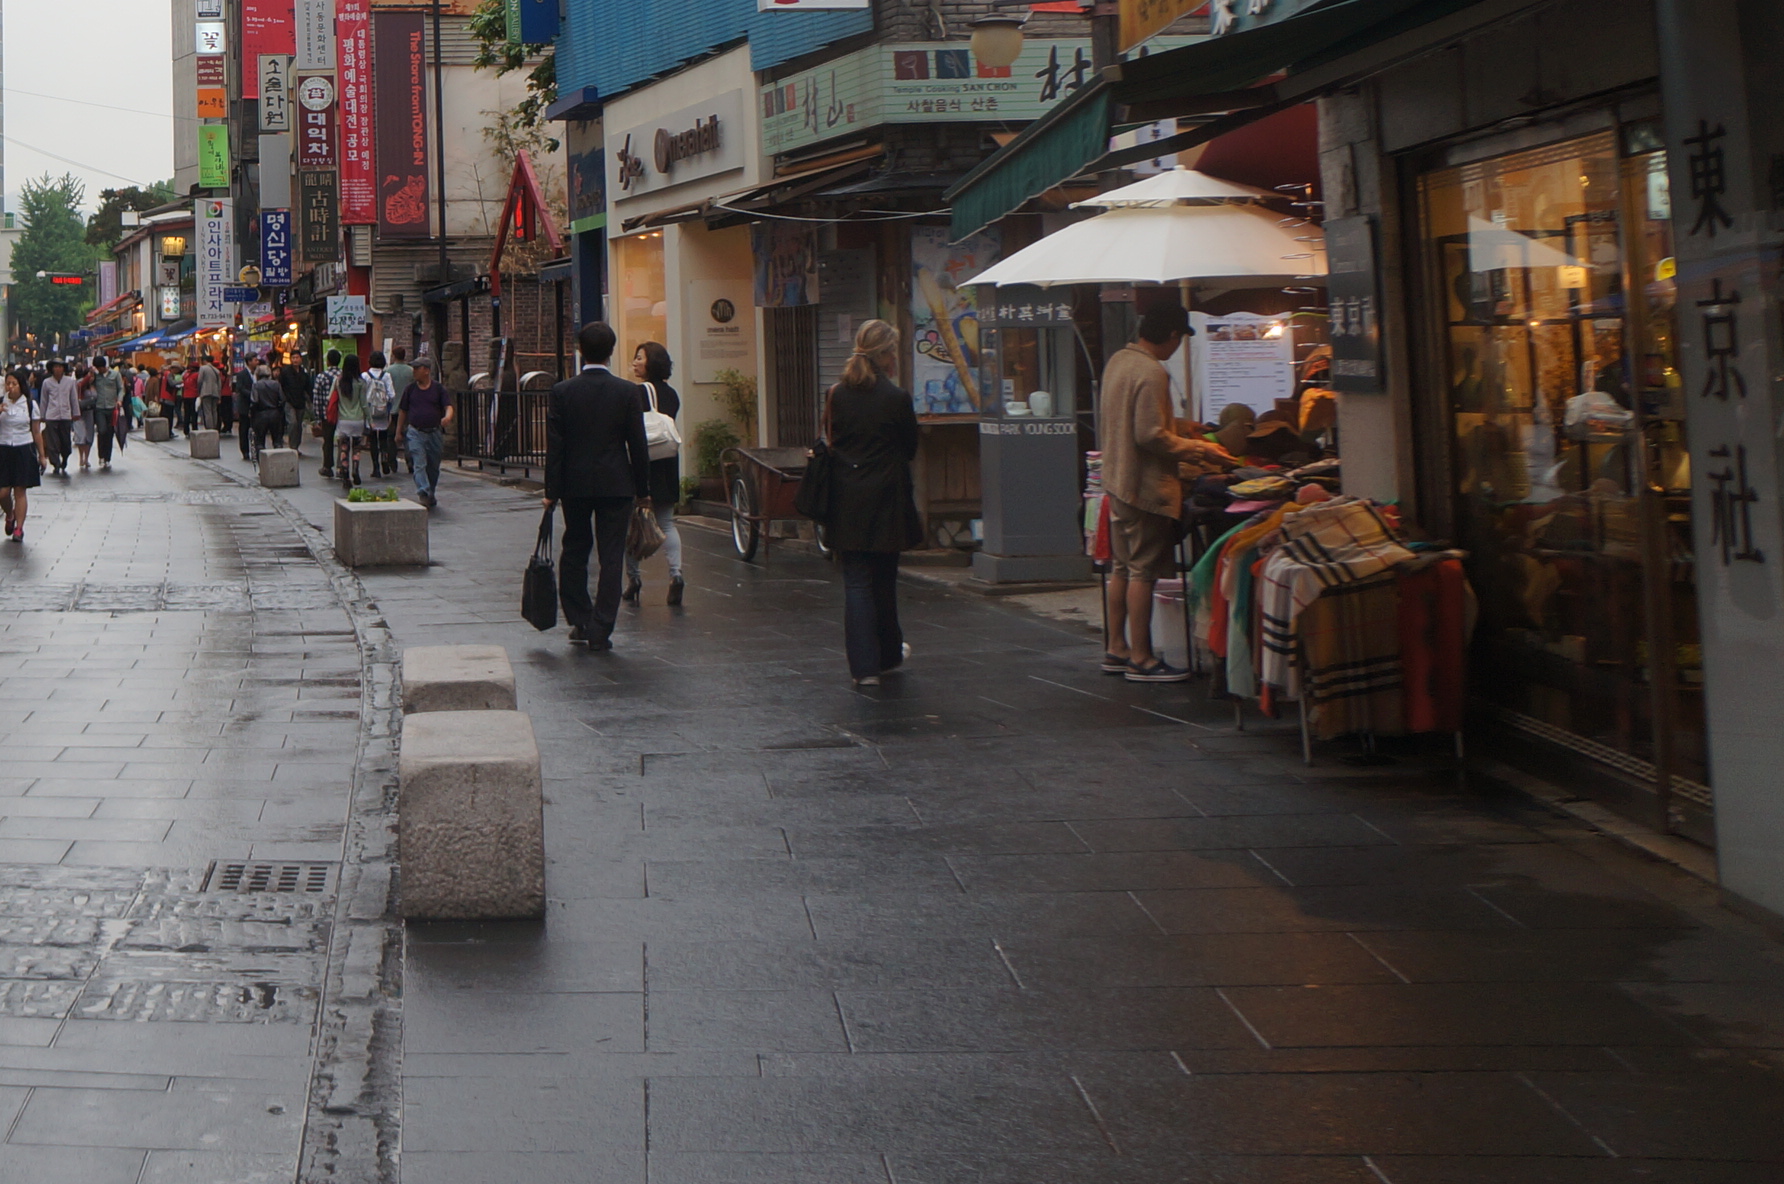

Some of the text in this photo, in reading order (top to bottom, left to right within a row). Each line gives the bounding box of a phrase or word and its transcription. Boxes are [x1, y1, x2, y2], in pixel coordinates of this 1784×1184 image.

[201, 32, 219, 49] 꽃
[342, 37, 360, 129] 평화예술대전
[409, 30, 422, 114] The Store from
[893, 82, 1017, 96] Temple Cooking SAN CHON
[906, 96, 999, 113] 사찰음식 산촌
[307, 112, 330, 156] 대익차
[345, 133, 360, 162] 공모
[266, 213, 287, 266] 명신당
[207, 220, 223, 312] 인사아트프라자
[999, 423, 1021, 435] PARK
